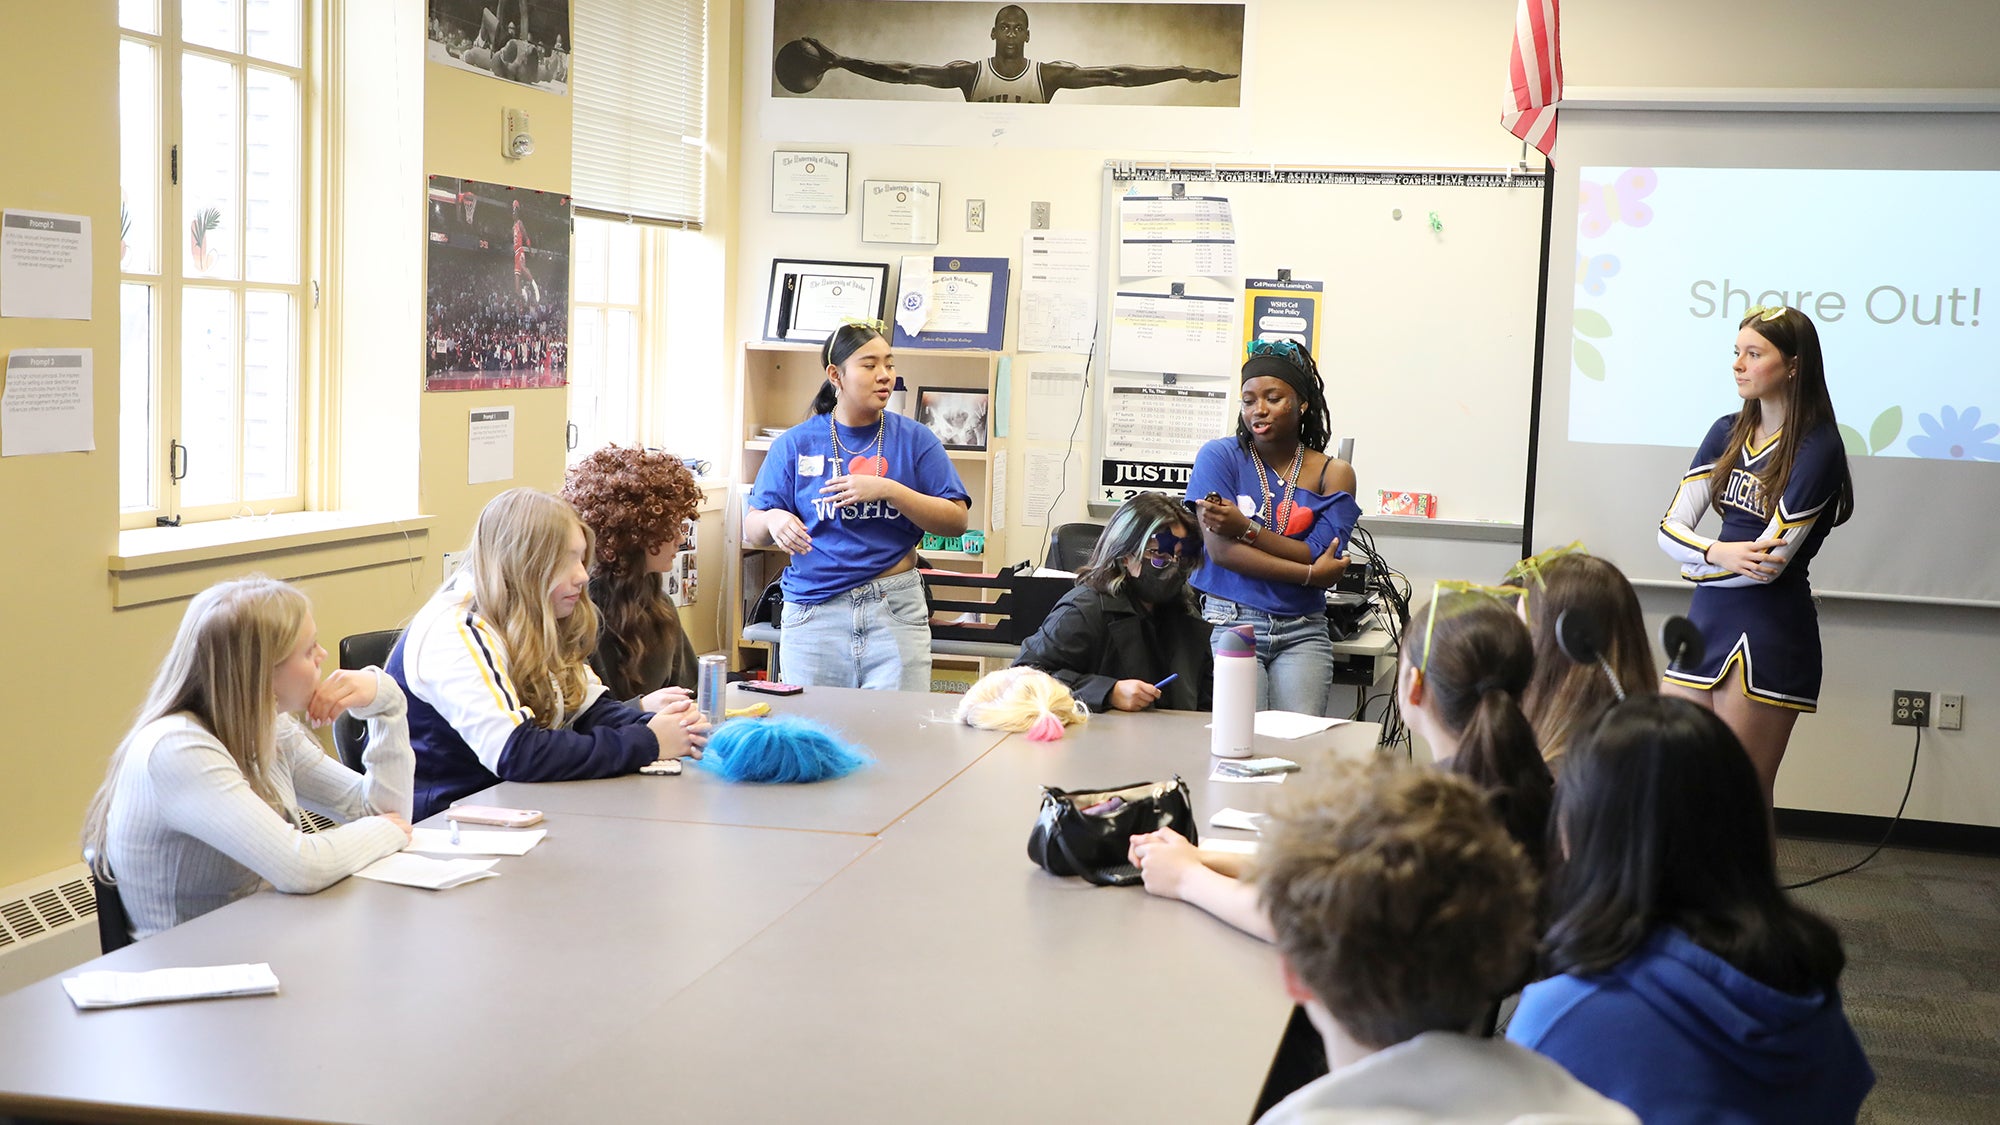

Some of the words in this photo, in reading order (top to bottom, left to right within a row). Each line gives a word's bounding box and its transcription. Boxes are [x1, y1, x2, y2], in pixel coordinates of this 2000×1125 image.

[1244, 171, 1286, 180] BELIEVE
[1422, 174, 1464, 183] BELIEVE
[29, 219, 50, 229] Prompt
[1689, 279, 1846, 323] Share
[1865, 285, 1982, 327] Out!
[30, 358, 50, 367] Prompt
